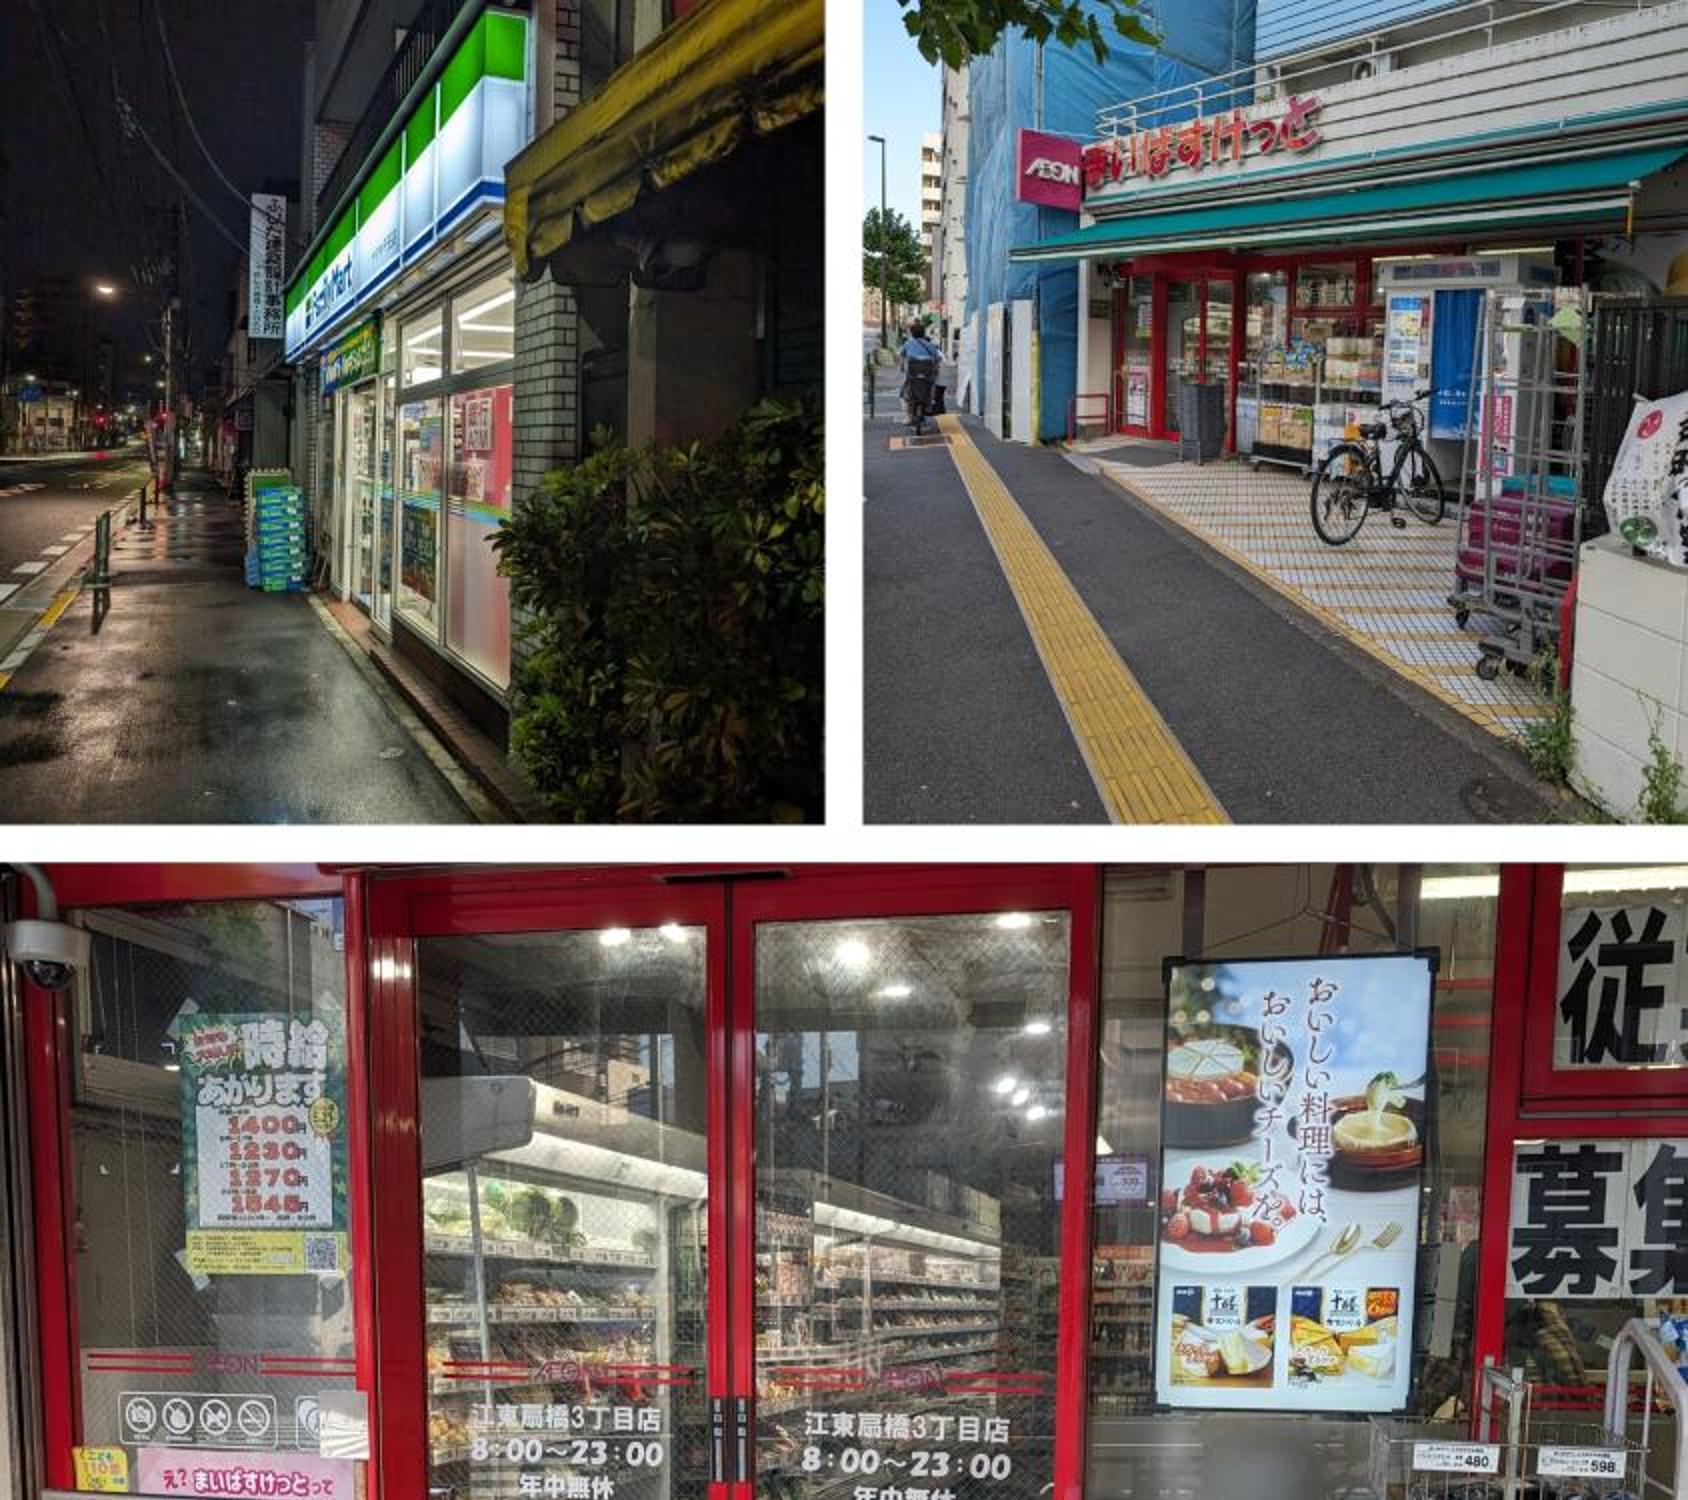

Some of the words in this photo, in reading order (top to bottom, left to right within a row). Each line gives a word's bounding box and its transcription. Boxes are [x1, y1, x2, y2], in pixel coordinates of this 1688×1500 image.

[1083, 95, 1323, 189] まいばすけっと
[1560, 906, 1688, 1064] 従
[242, 1019, 328, 1071] 時給
[198, 1070, 327, 1106] あがります
[1299, 976, 1338, 1223] おいしい料理には、
[1251, 990, 1291, 1227] おいしいチーズを。
[471, 1403, 661, 1432] 江東扇橋3丁目店
[804, 1411, 1011, 1443] 江東扇橋3丁目店
[1465, 1454, 1489, 1468] 480
[1590, 1459, 1616, 1473] 598
[519, 1473, 615, 1500] 年中無休
